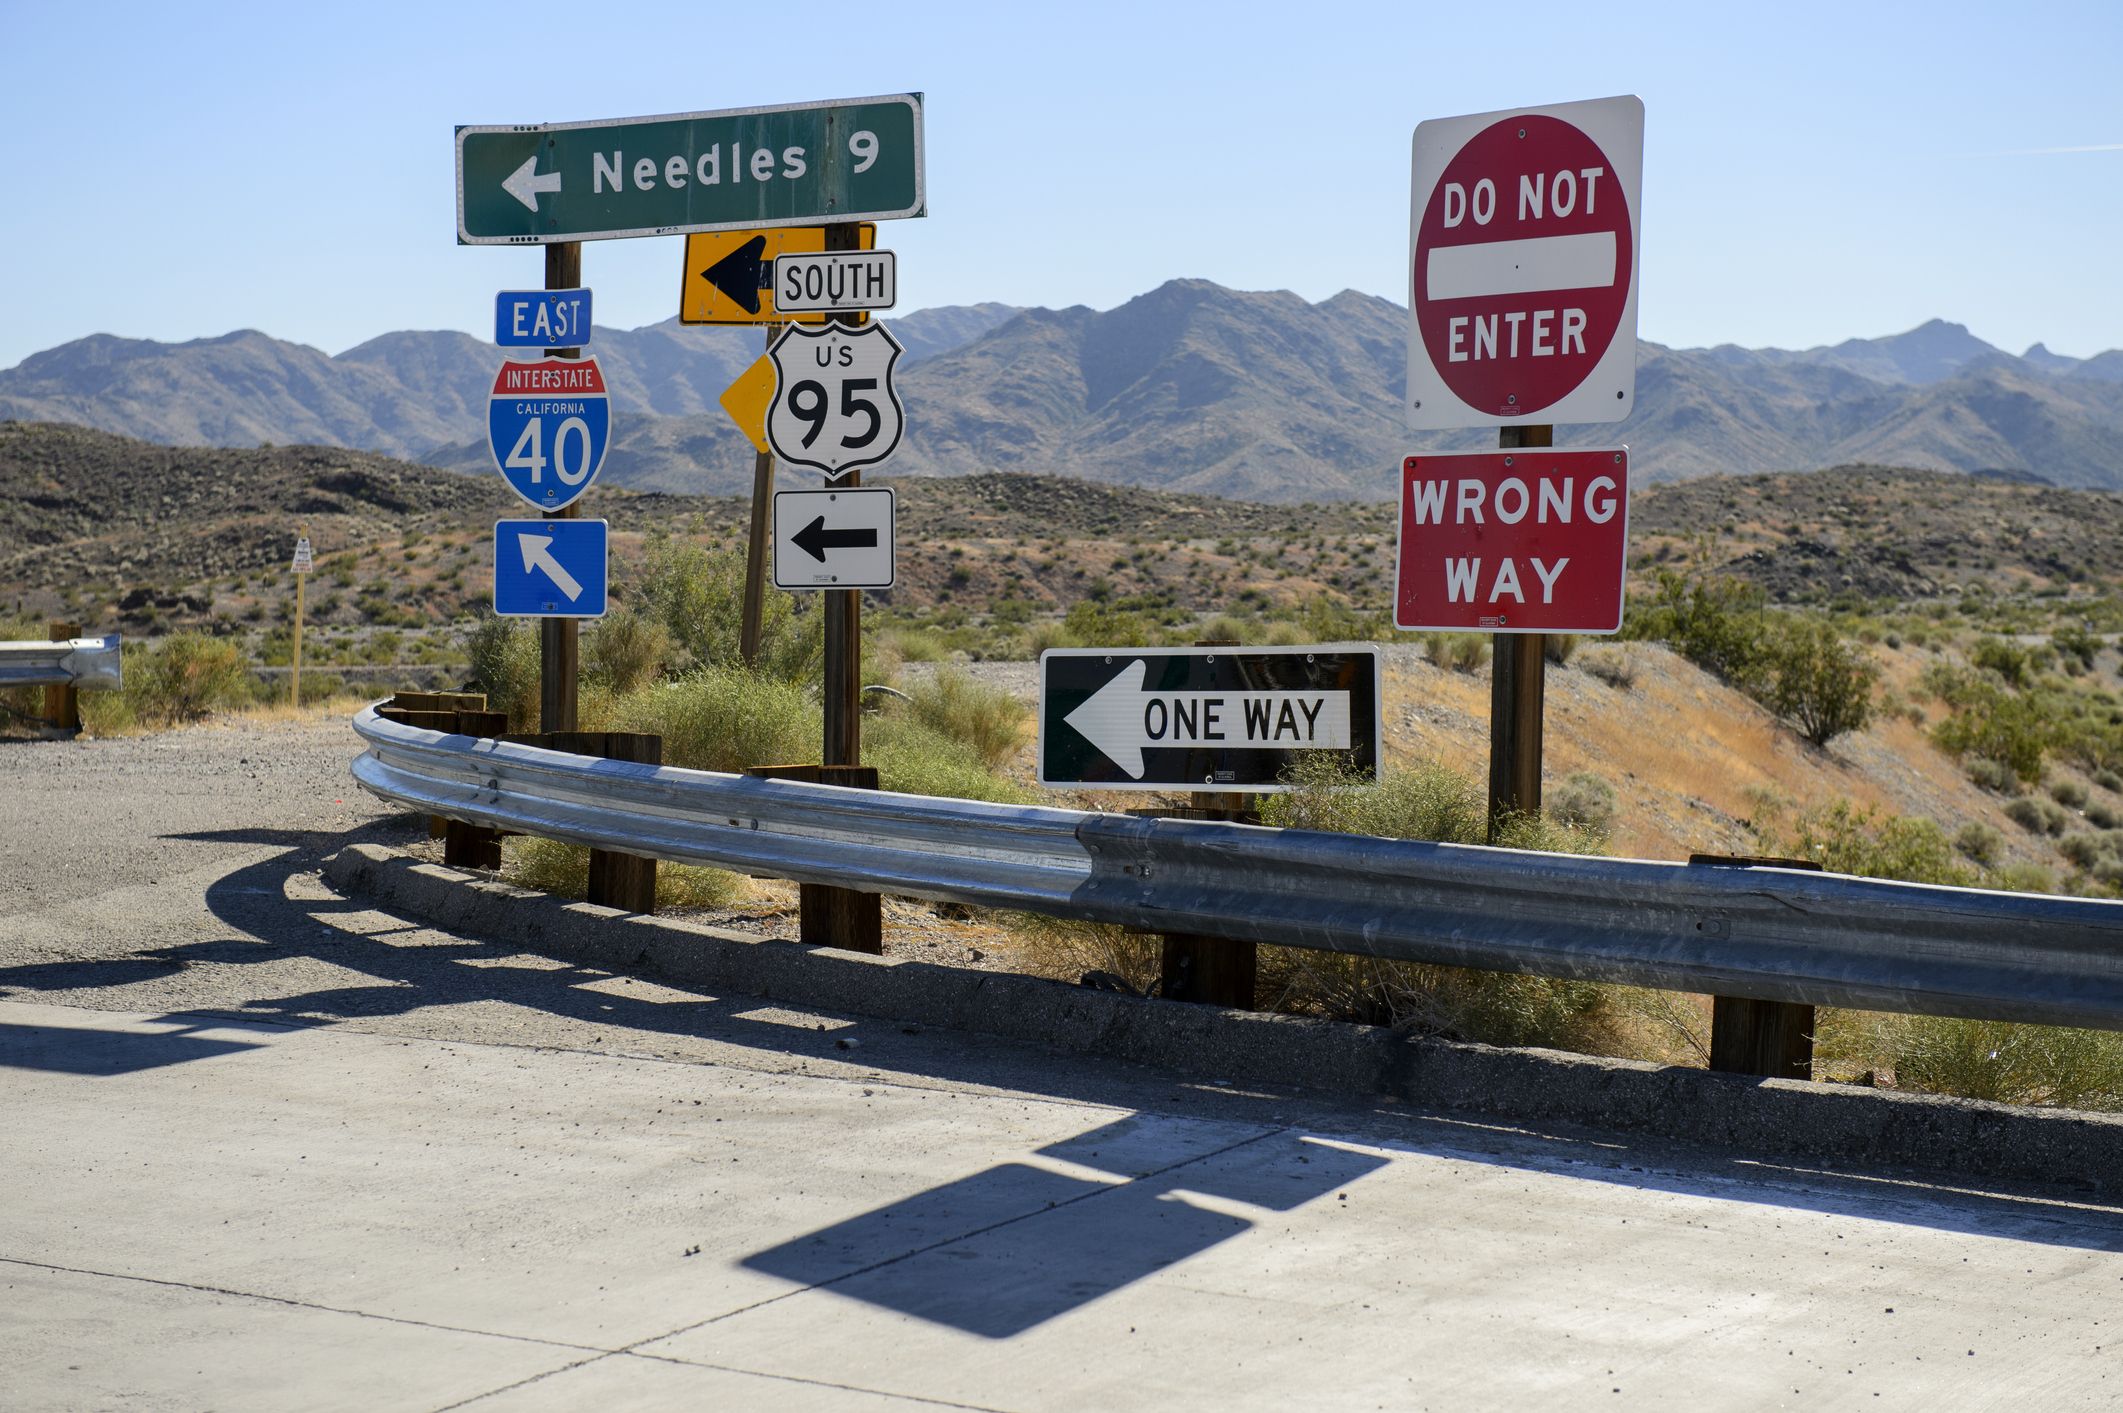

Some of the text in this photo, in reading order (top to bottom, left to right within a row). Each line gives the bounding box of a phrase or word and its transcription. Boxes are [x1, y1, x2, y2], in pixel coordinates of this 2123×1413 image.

[593, 130, 880, 194] Needles 9
[1444, 166, 1604, 229] DO NOT
[785, 262, 884, 301] SOUTH
[513, 300, 580, 337] EAST
[1448, 308, 1587, 363] ENTER
[507, 369, 594, 389] INTERSTATE
[816, 346, 853, 367] US
[516, 402, 585, 415] CALIFORNIA
[787, 378, 881, 450] 95
[505, 417, 592, 487] 40
[1412, 476, 1617, 525] WRONG
[1445, 557, 1570, 604] WAY
[1144, 698, 1324, 741] ONE WAY
